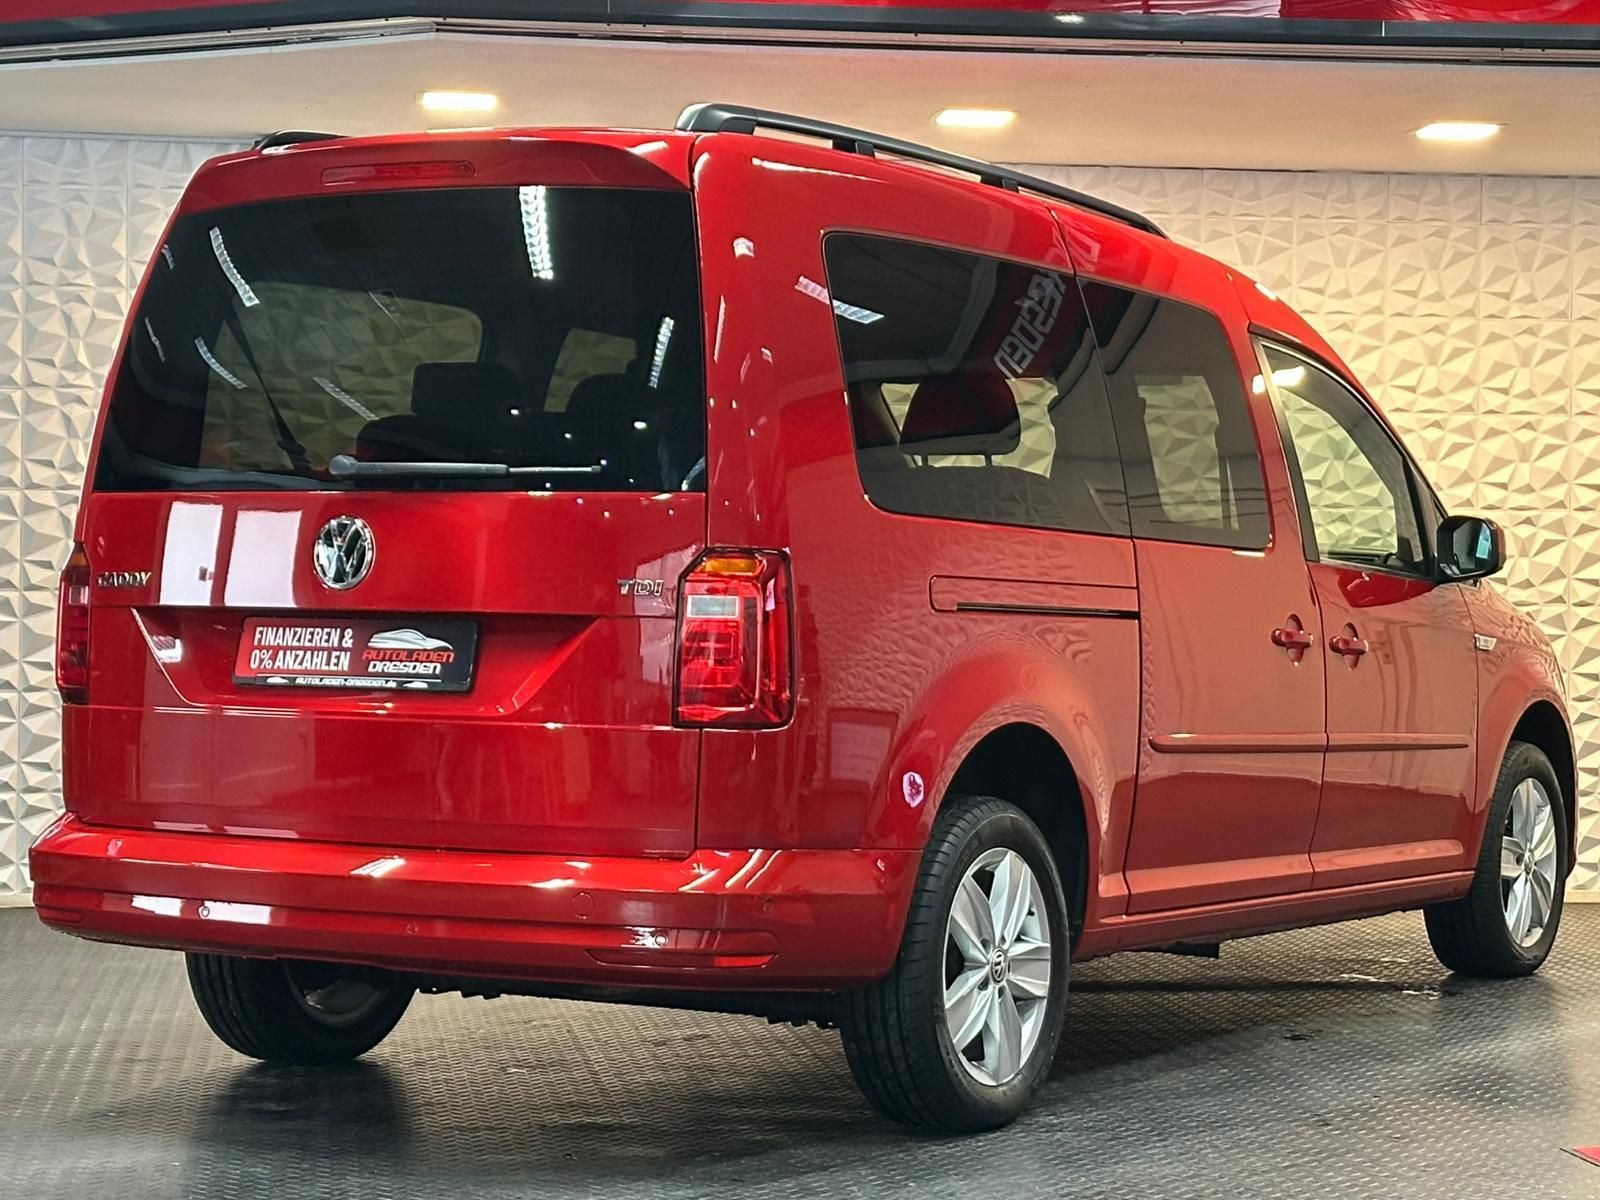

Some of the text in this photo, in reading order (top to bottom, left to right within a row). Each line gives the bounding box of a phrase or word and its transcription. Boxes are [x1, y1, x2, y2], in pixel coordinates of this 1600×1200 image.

[617, 578, 664, 595] TDI
[253, 626, 354, 648] FINANZIEREN &
[249, 650, 351, 671] 0% ANZAHLEN
[362, 649, 455, 663] AUTOLADEN
[367, 661, 441, 675] DRESDEN
